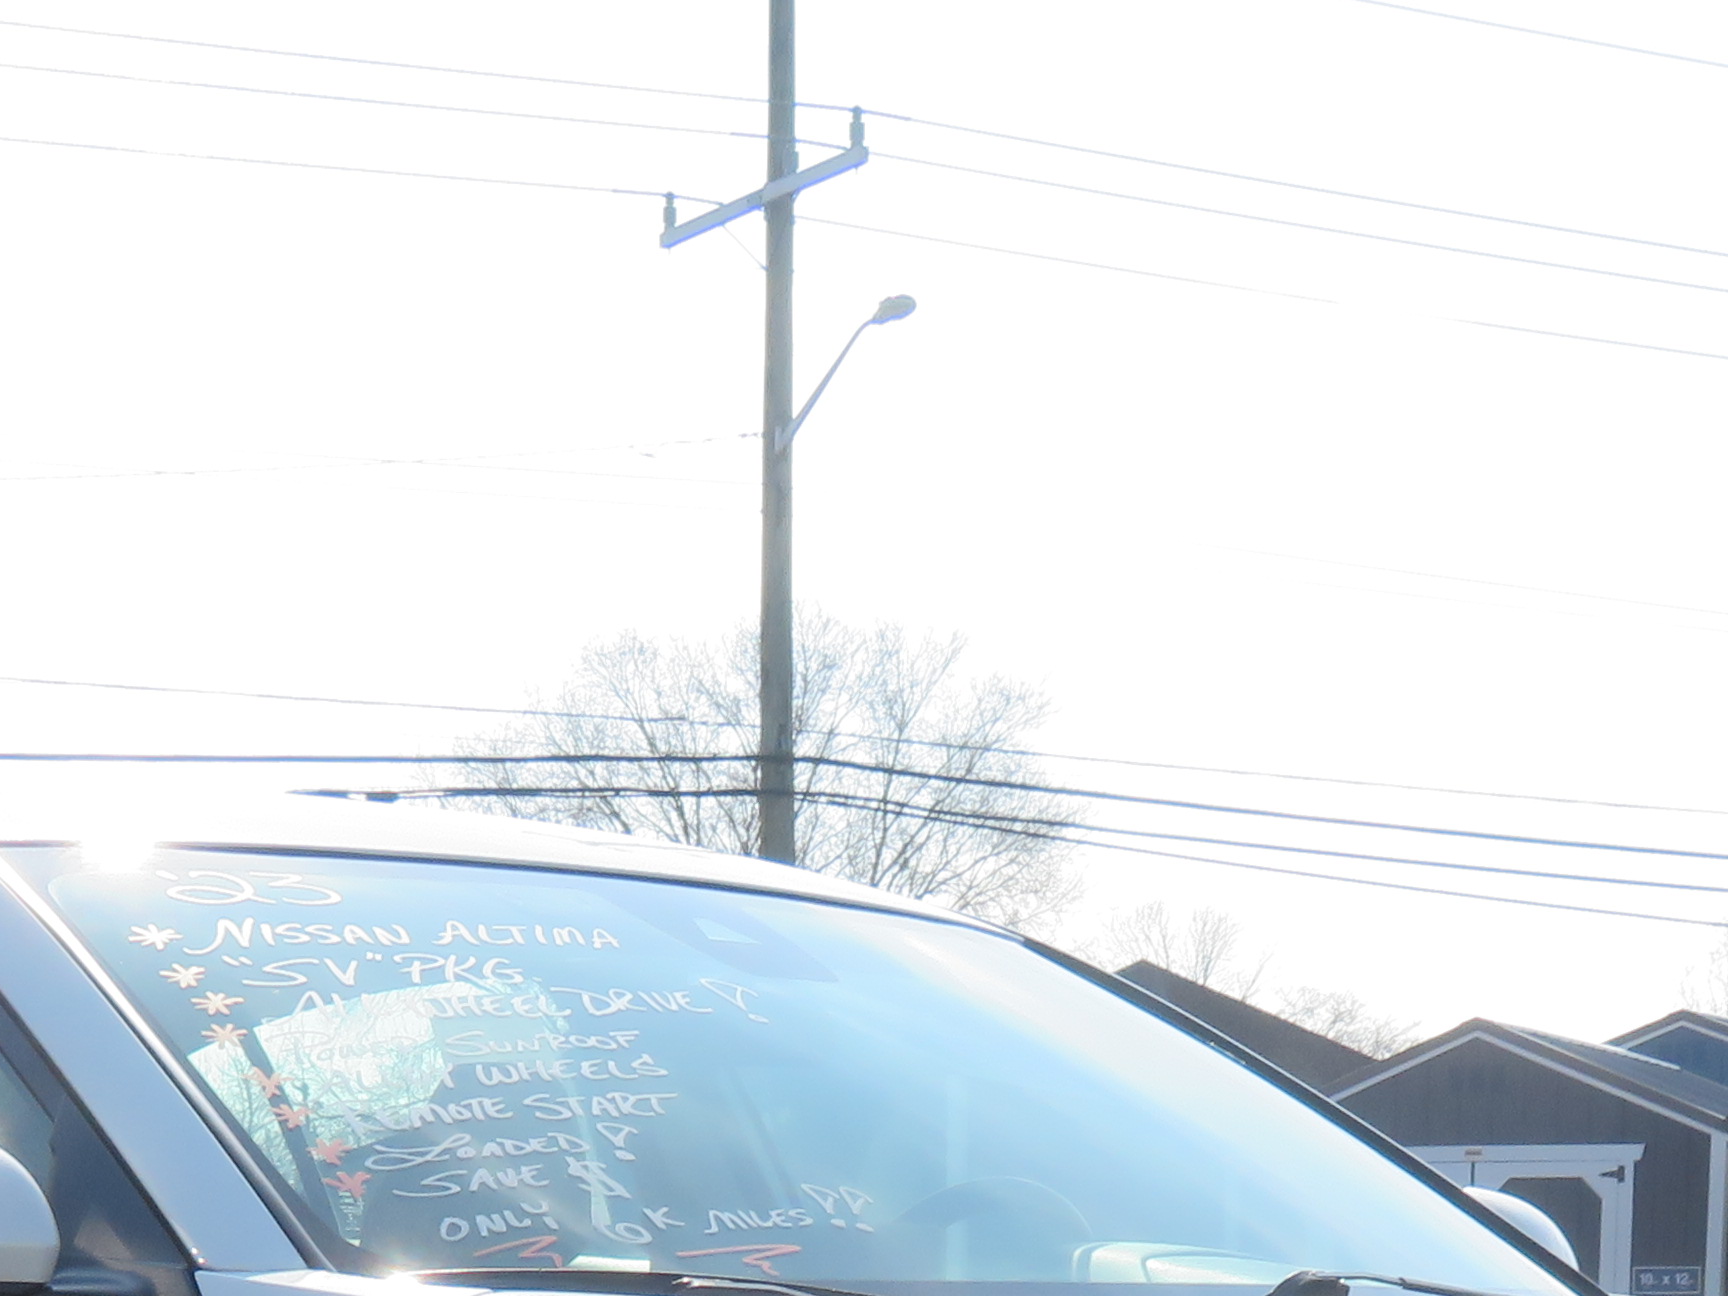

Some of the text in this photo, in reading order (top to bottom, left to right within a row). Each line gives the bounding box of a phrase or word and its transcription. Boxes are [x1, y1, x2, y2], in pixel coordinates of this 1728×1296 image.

[182, 917, 621, 956] NISSAN ALTIMA
[415, 994, 572, 1018] WHEEL
[445, 1030, 641, 1057] SUNROOF
[474, 1053, 670, 1084] WHEELS
[340, 1091, 679, 1135] REMOTE START
[391, 1163, 551, 1198] SAVE
[439, 1199, 561, 1242] ONLY
